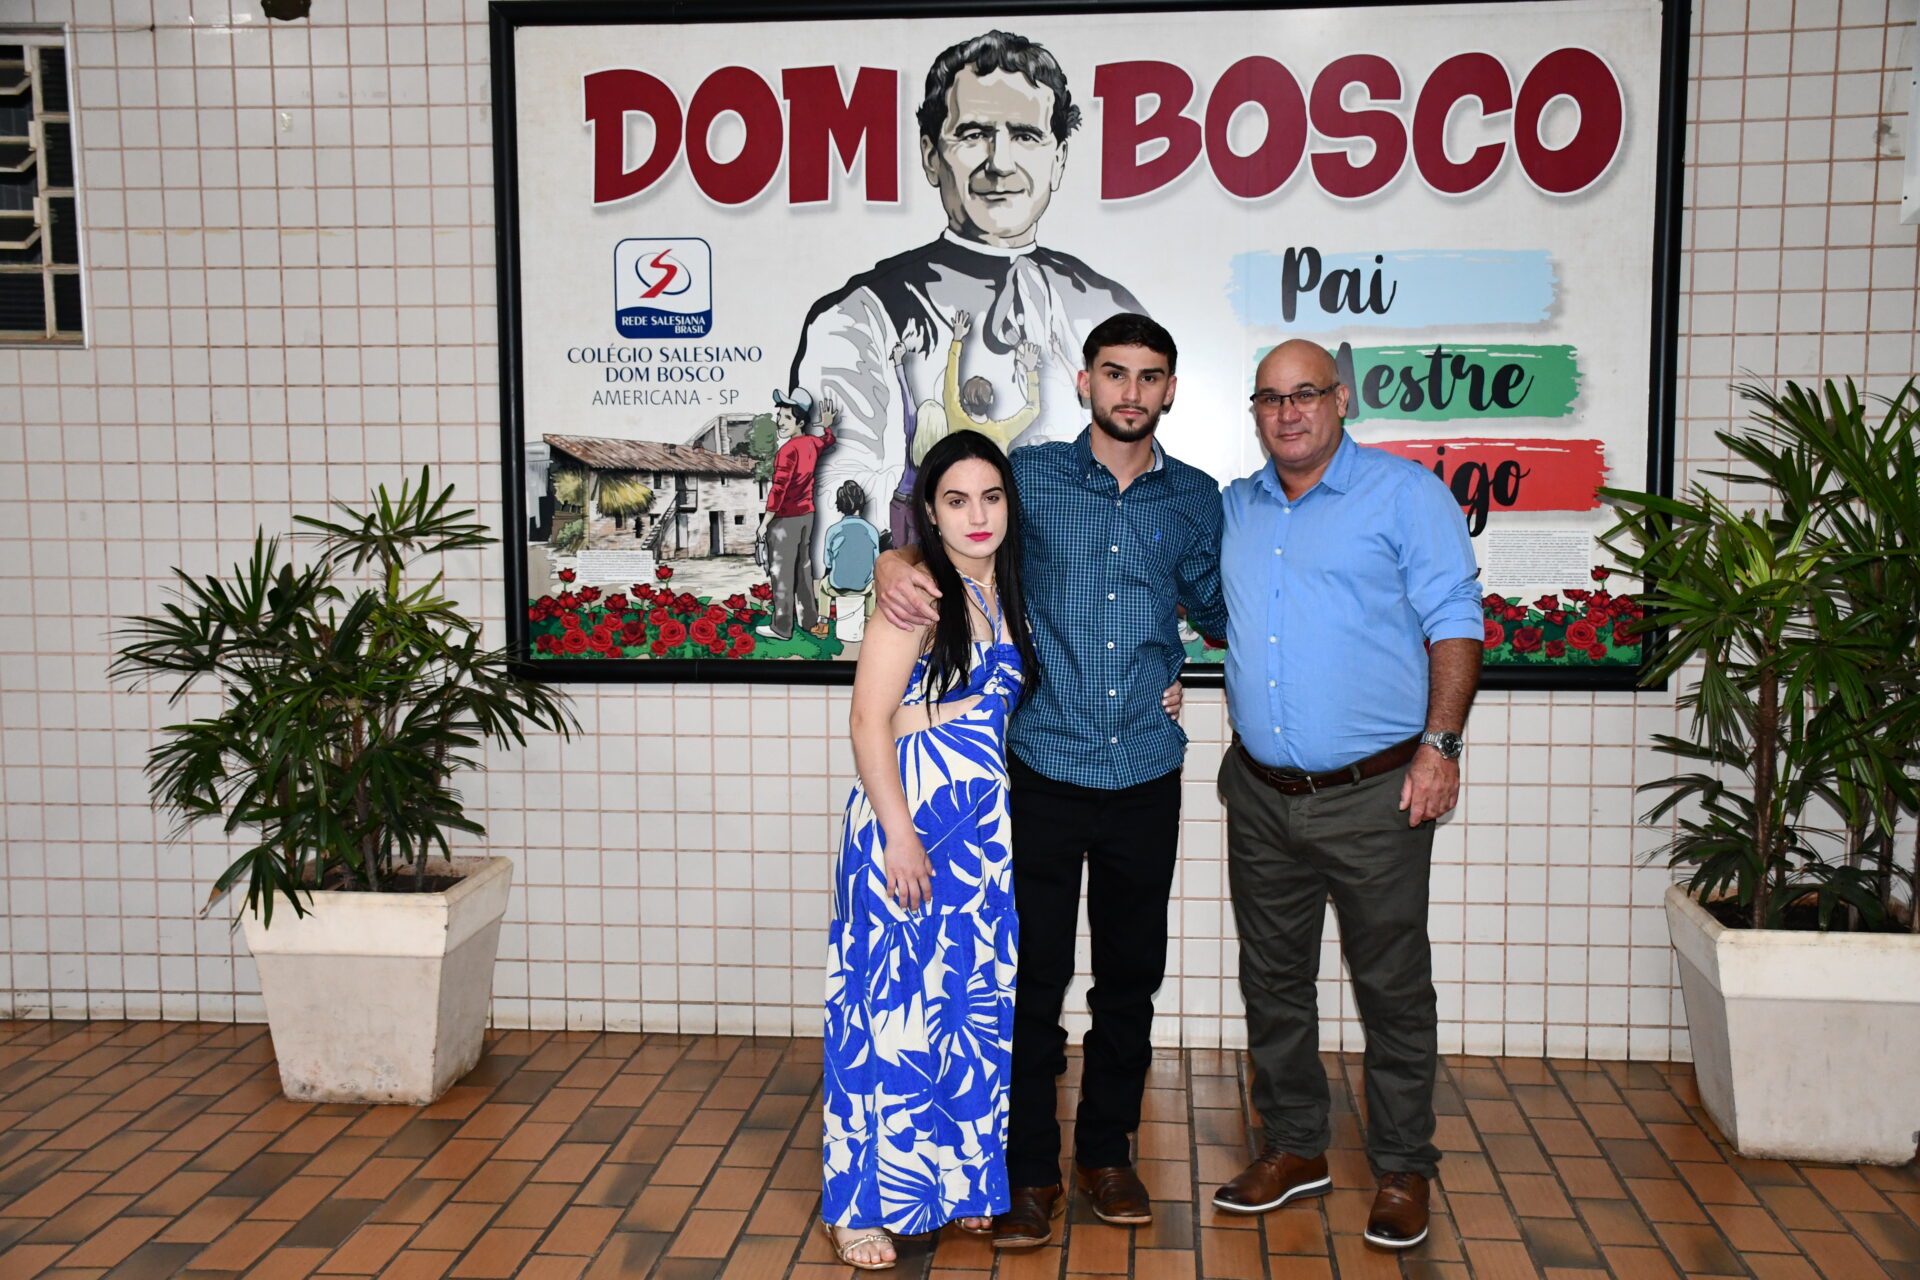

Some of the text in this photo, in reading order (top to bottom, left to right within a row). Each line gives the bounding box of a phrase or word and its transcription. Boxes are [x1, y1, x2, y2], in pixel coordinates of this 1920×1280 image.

[585, 47, 1623, 203] DOM BOSCO
[1281, 246, 1397, 323] Pai
[621, 315, 706, 326] REDE SALESIANA
[674, 325, 705, 334] BRASIL
[567, 343, 763, 364] COLÉGIO SALESIANO
[606, 366, 725, 383] DOM BOSCO
[592, 389, 701, 406] AMERICANA
[719, 389, 740, 405] SP
